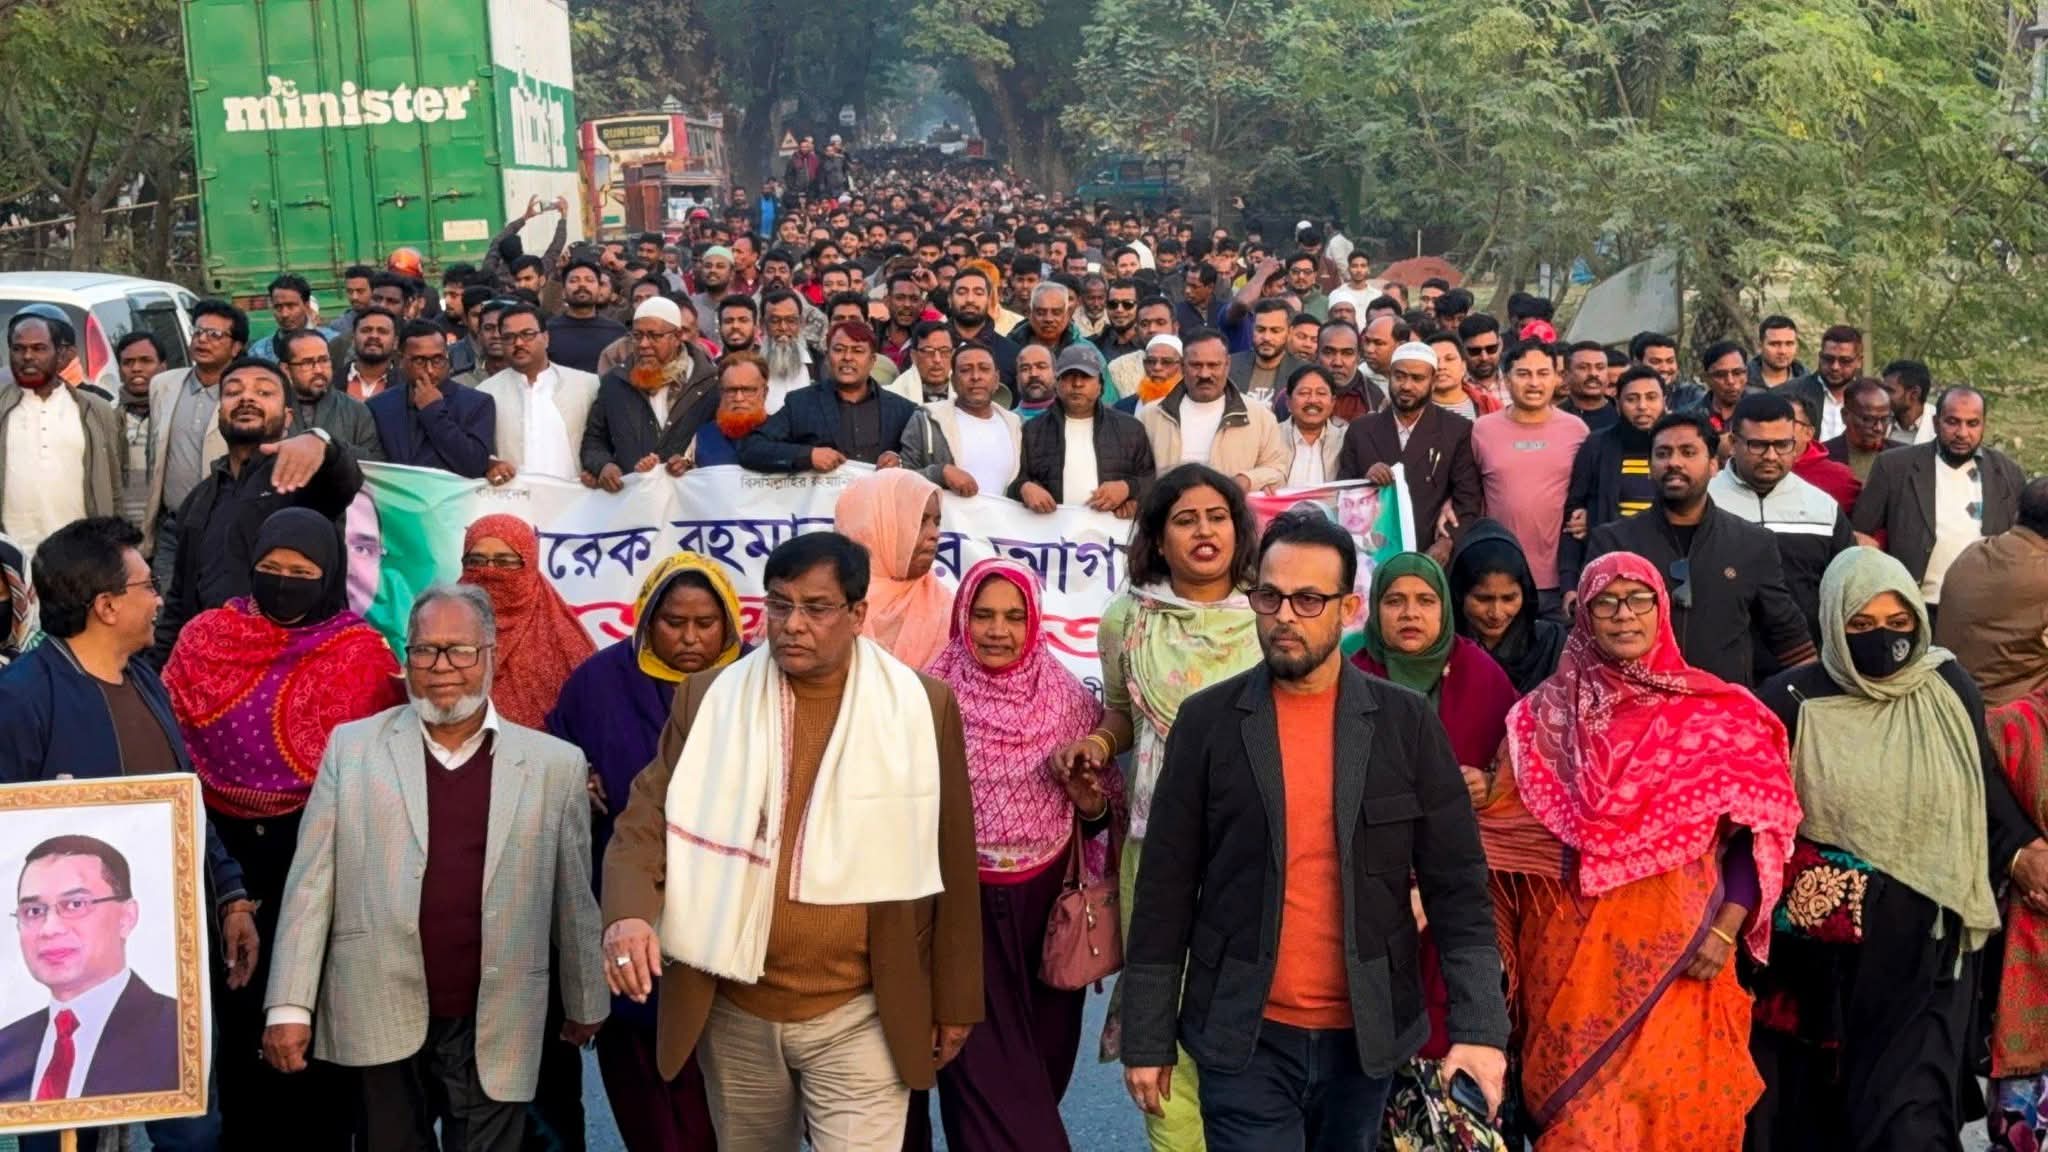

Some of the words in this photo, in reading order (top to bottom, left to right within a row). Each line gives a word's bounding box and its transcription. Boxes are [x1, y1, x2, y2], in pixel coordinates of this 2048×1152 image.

[223, 75, 472, 132] minister
[534, 525, 660, 579] রেক
[670, 513, 835, 576] রহমা
[988, 536, 1128, 593] আগ
